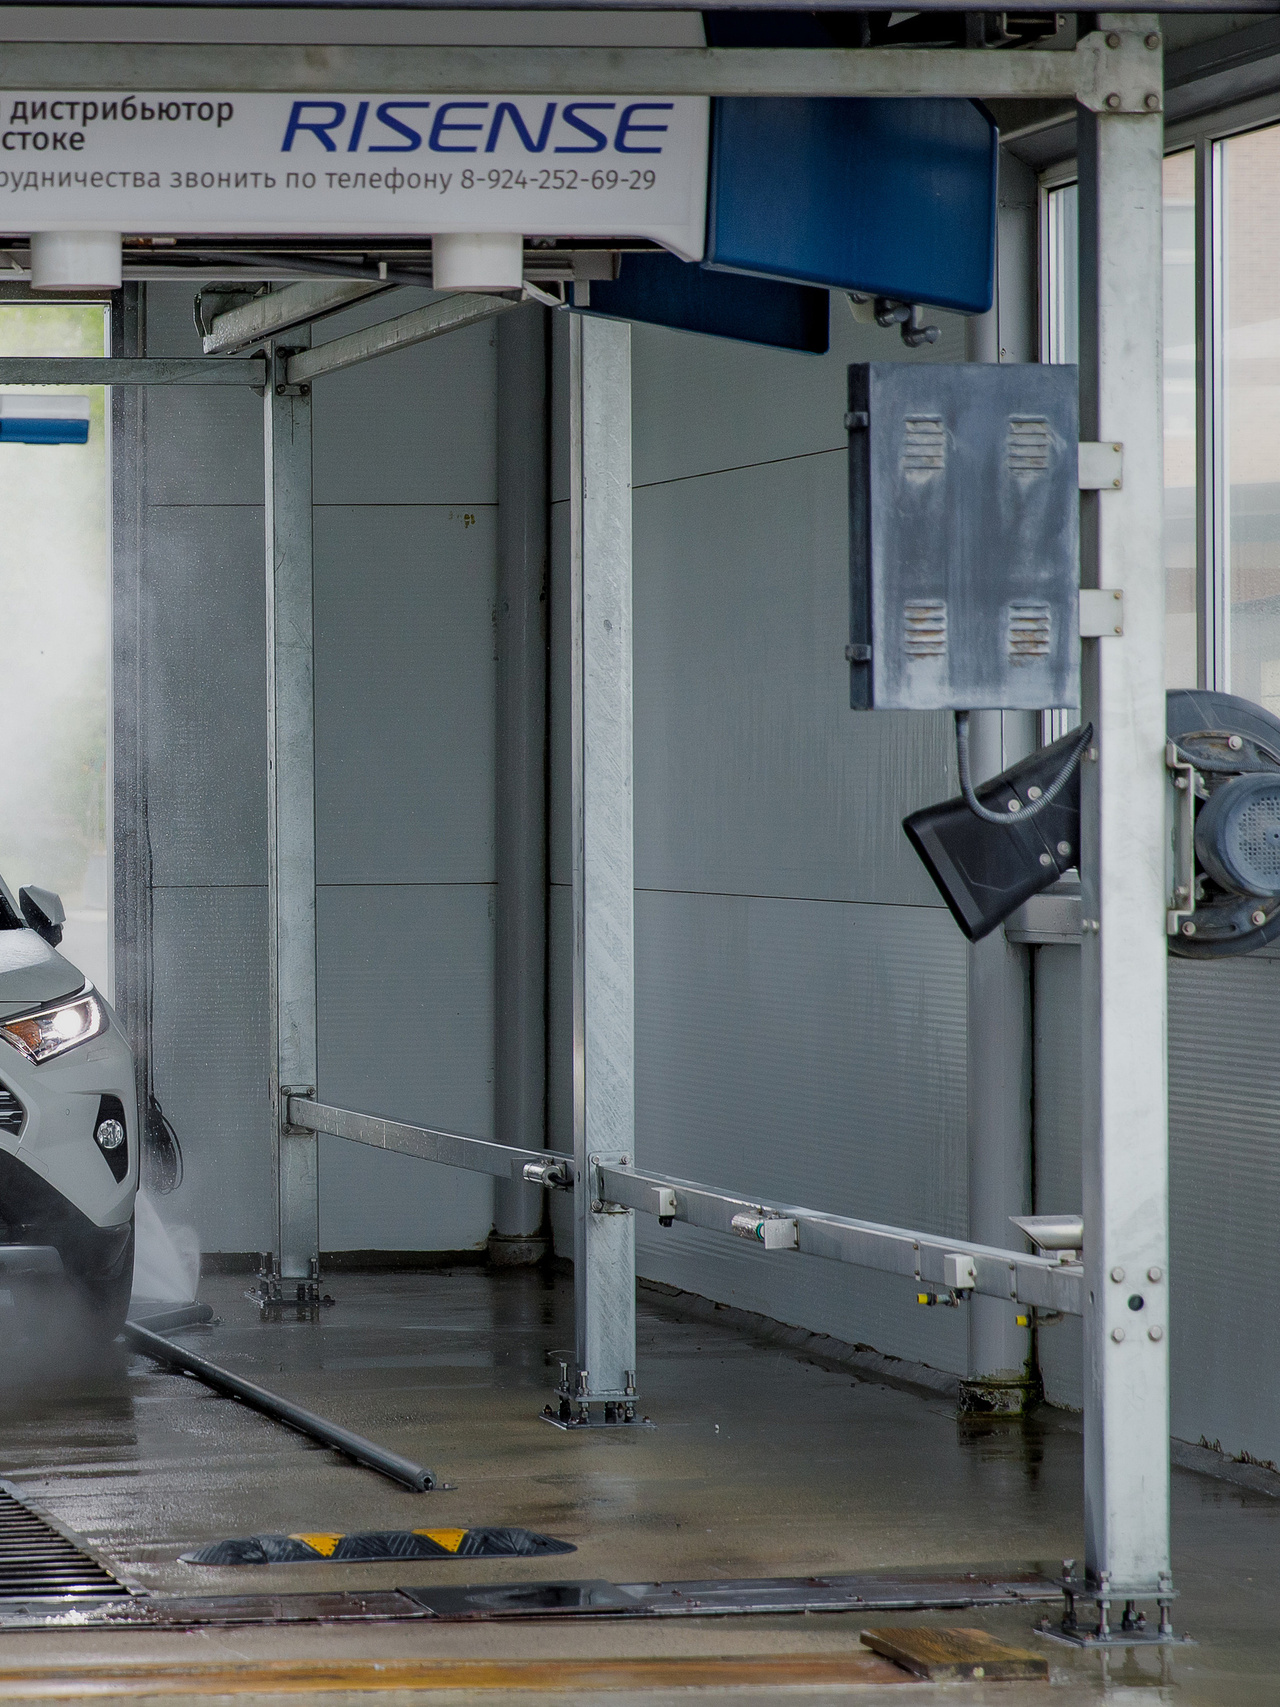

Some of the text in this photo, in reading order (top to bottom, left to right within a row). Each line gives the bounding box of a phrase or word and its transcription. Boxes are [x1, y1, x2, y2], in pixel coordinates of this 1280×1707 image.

[9, 96, 235, 127] дистрибьютор
[280, 100, 675, 155] RISENSE
[169, 171, 277, 189] звонить
[286, 171, 317, 189] по
[325, 166, 453, 195] телефону
[460, 168, 656, 191] 8-924-252-69-29
